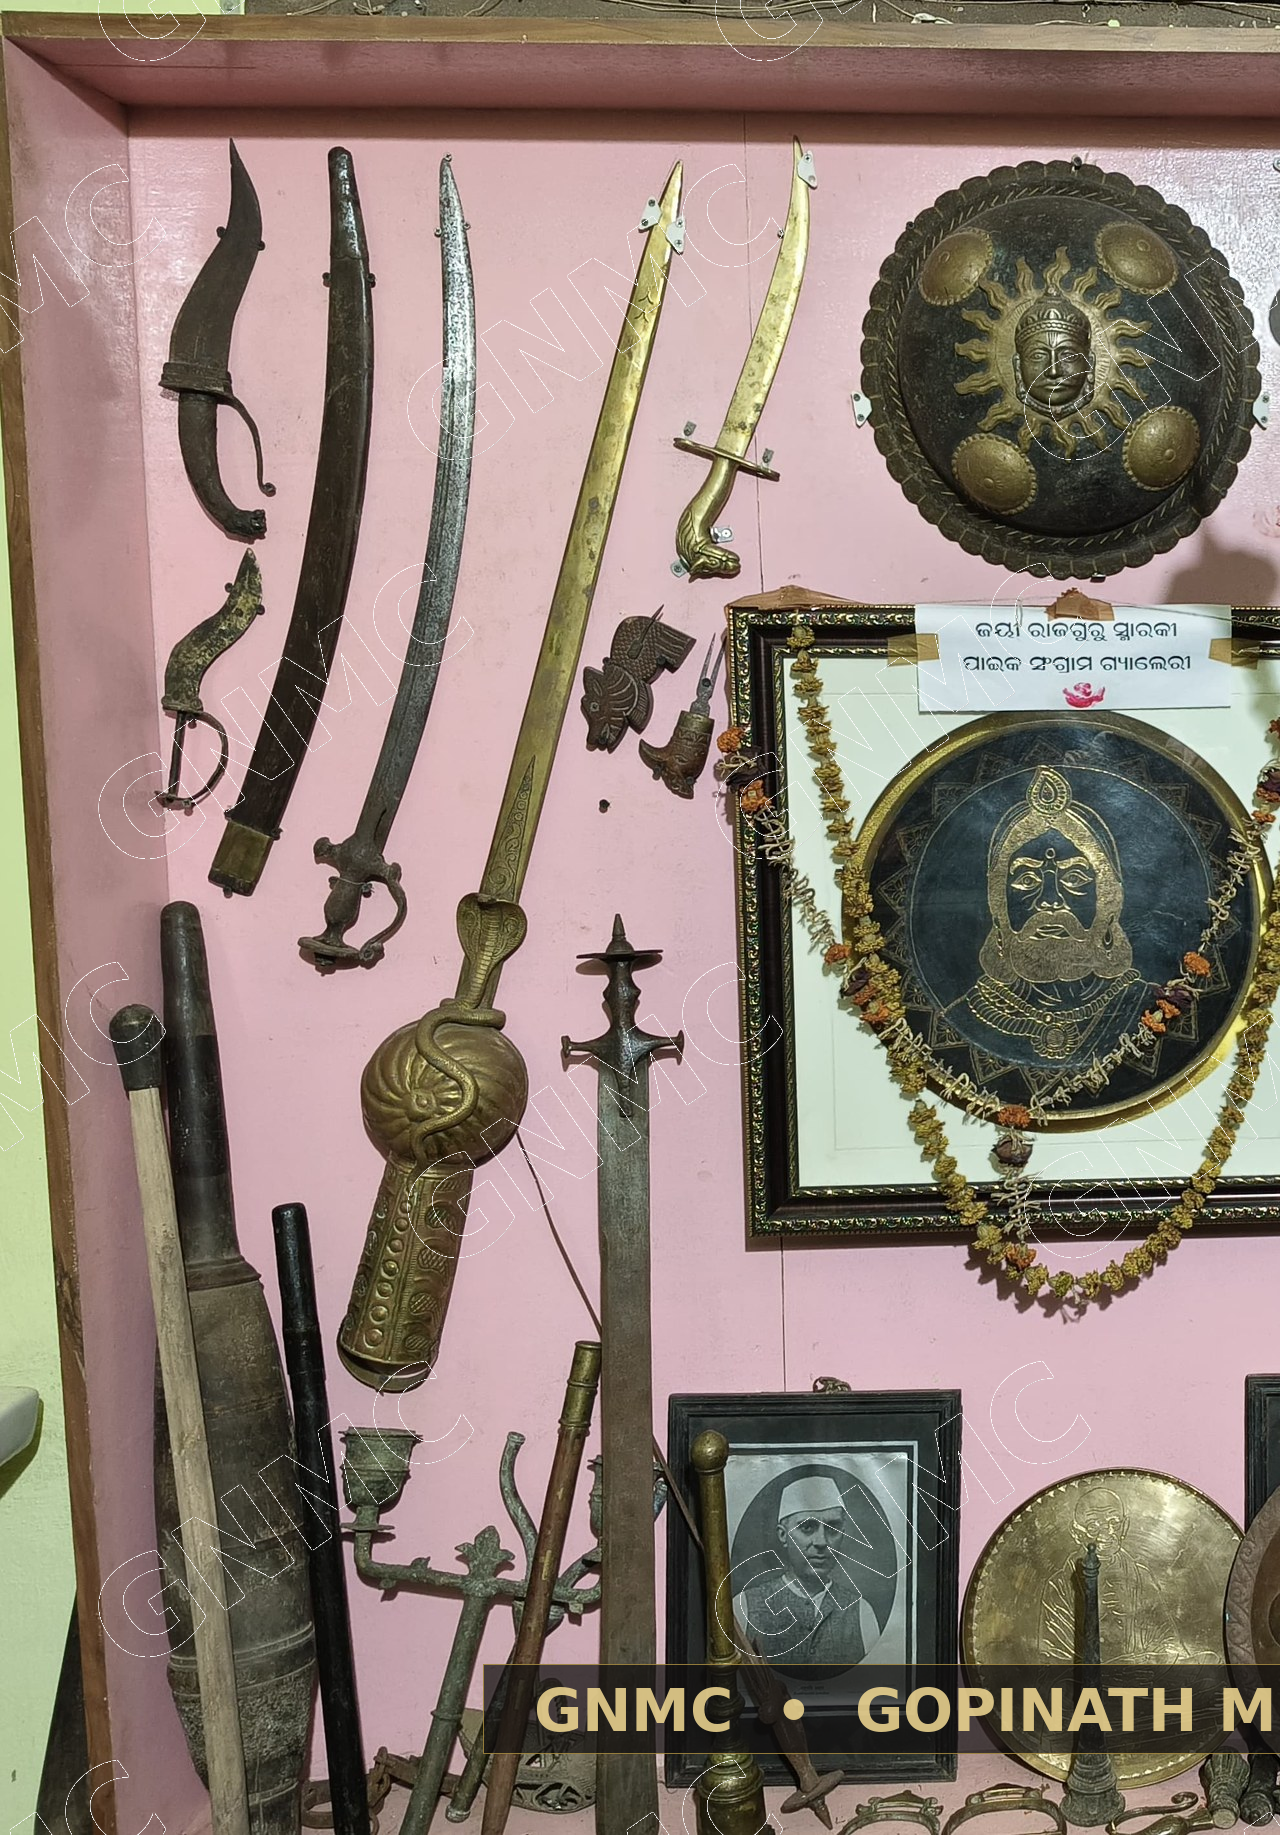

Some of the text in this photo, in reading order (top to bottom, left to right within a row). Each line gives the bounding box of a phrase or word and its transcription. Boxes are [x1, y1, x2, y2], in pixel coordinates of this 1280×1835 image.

[1028, 622, 1107, 641] ରାଜଗୁରୁ
[963, 656, 1022, 672] ପାଇକ
[1030, 656, 1093, 673] ସଂଗ୍ରାମ
